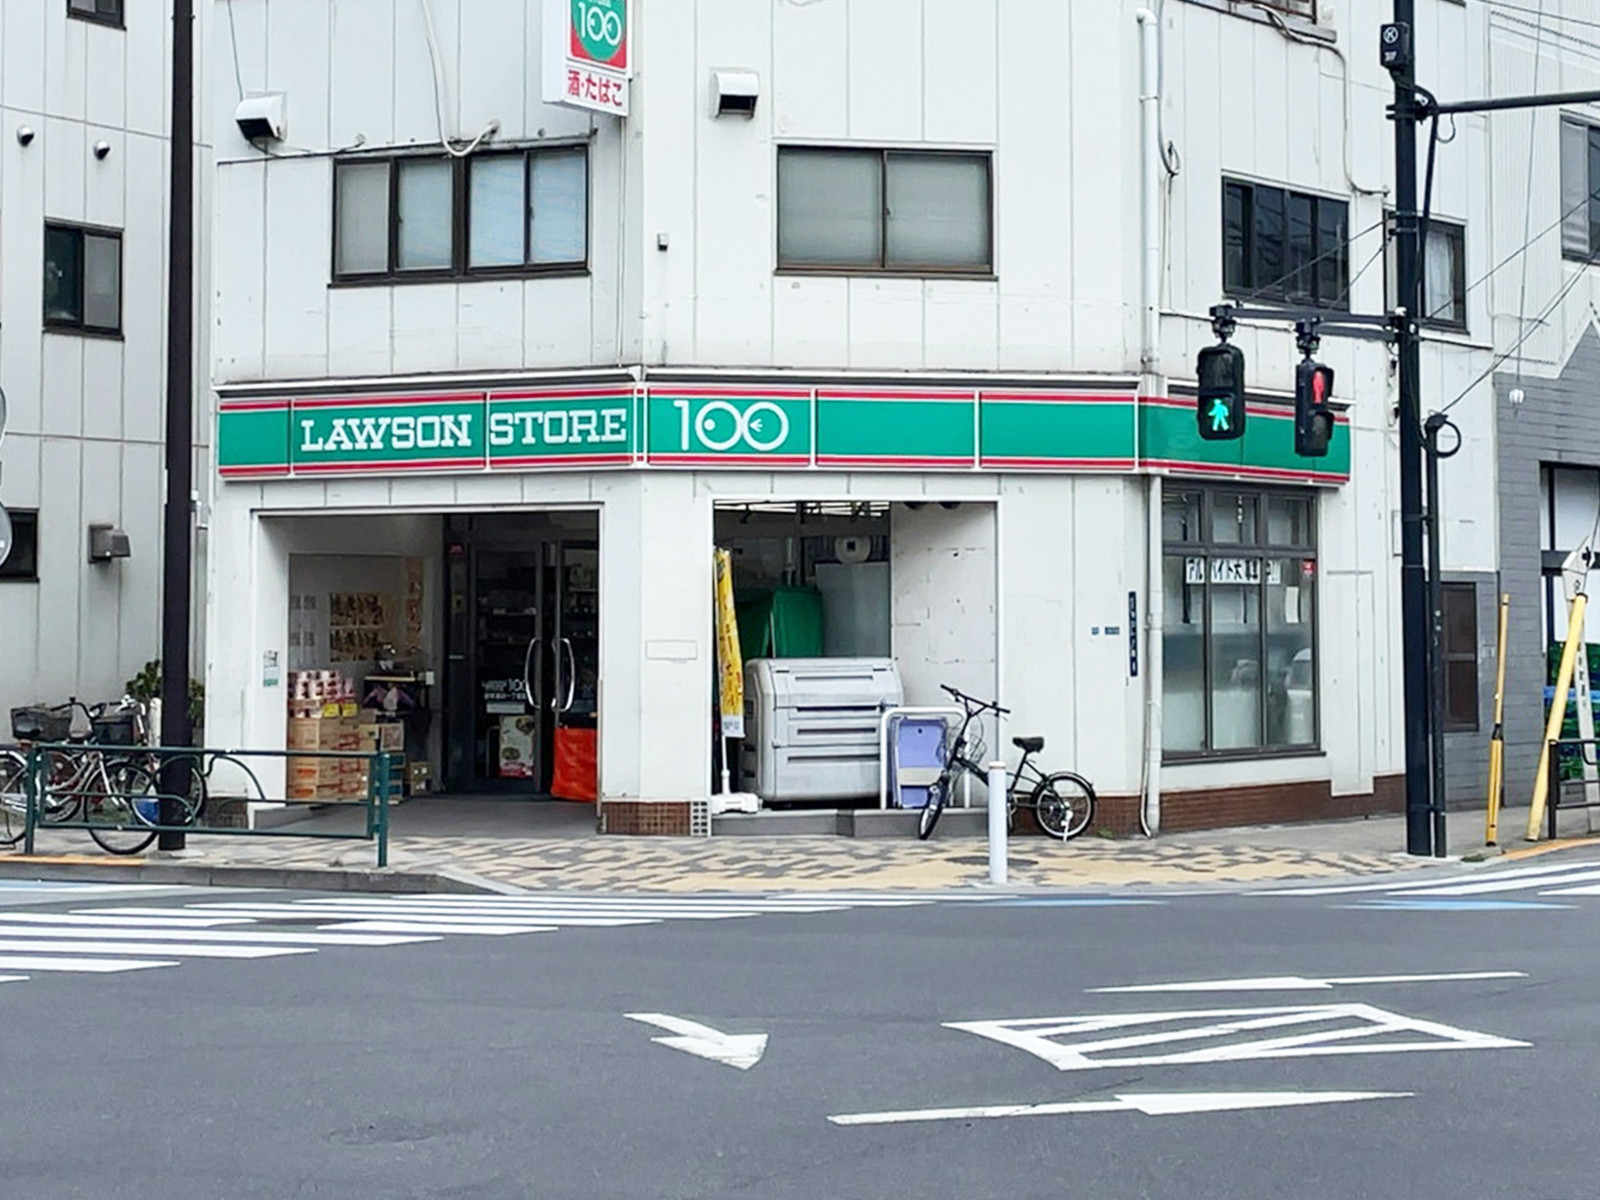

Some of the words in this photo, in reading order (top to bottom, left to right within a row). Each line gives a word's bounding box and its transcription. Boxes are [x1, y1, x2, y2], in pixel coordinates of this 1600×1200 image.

[578, 2, 622, 46] 100
[301, 413, 473, 451] LAWSON
[489, 408, 627, 445] STORE
[673, 399, 789, 451] 100
